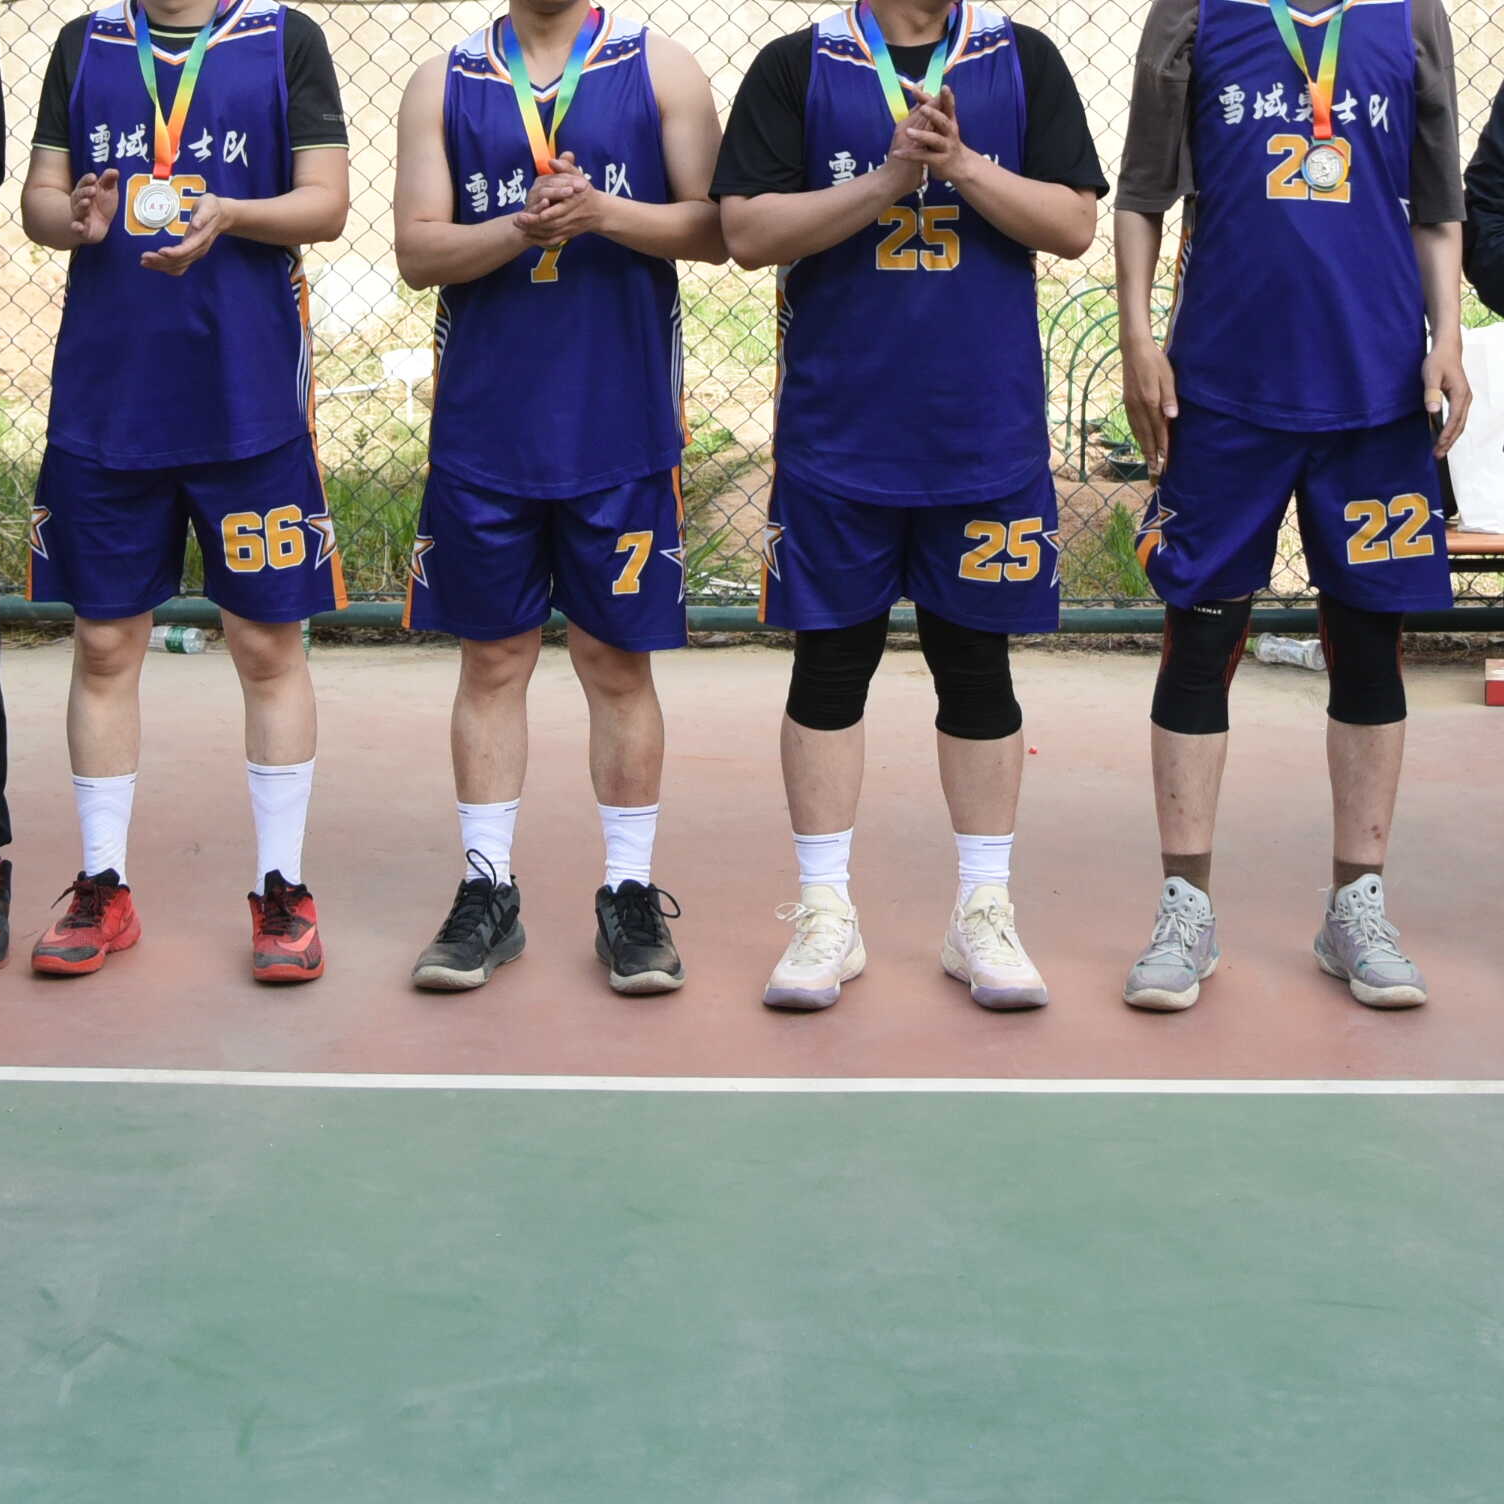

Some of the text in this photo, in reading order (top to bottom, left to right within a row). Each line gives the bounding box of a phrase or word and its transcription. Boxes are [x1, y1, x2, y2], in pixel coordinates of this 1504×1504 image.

[89, 123, 248, 167] 雪域士队
[876, 205, 960, 271] 25
[220, 503, 306, 573] 66
[612, 529, 655, 596] 7
[958, 516, 1044, 584] 25
[1343, 492, 1435, 566] 22
